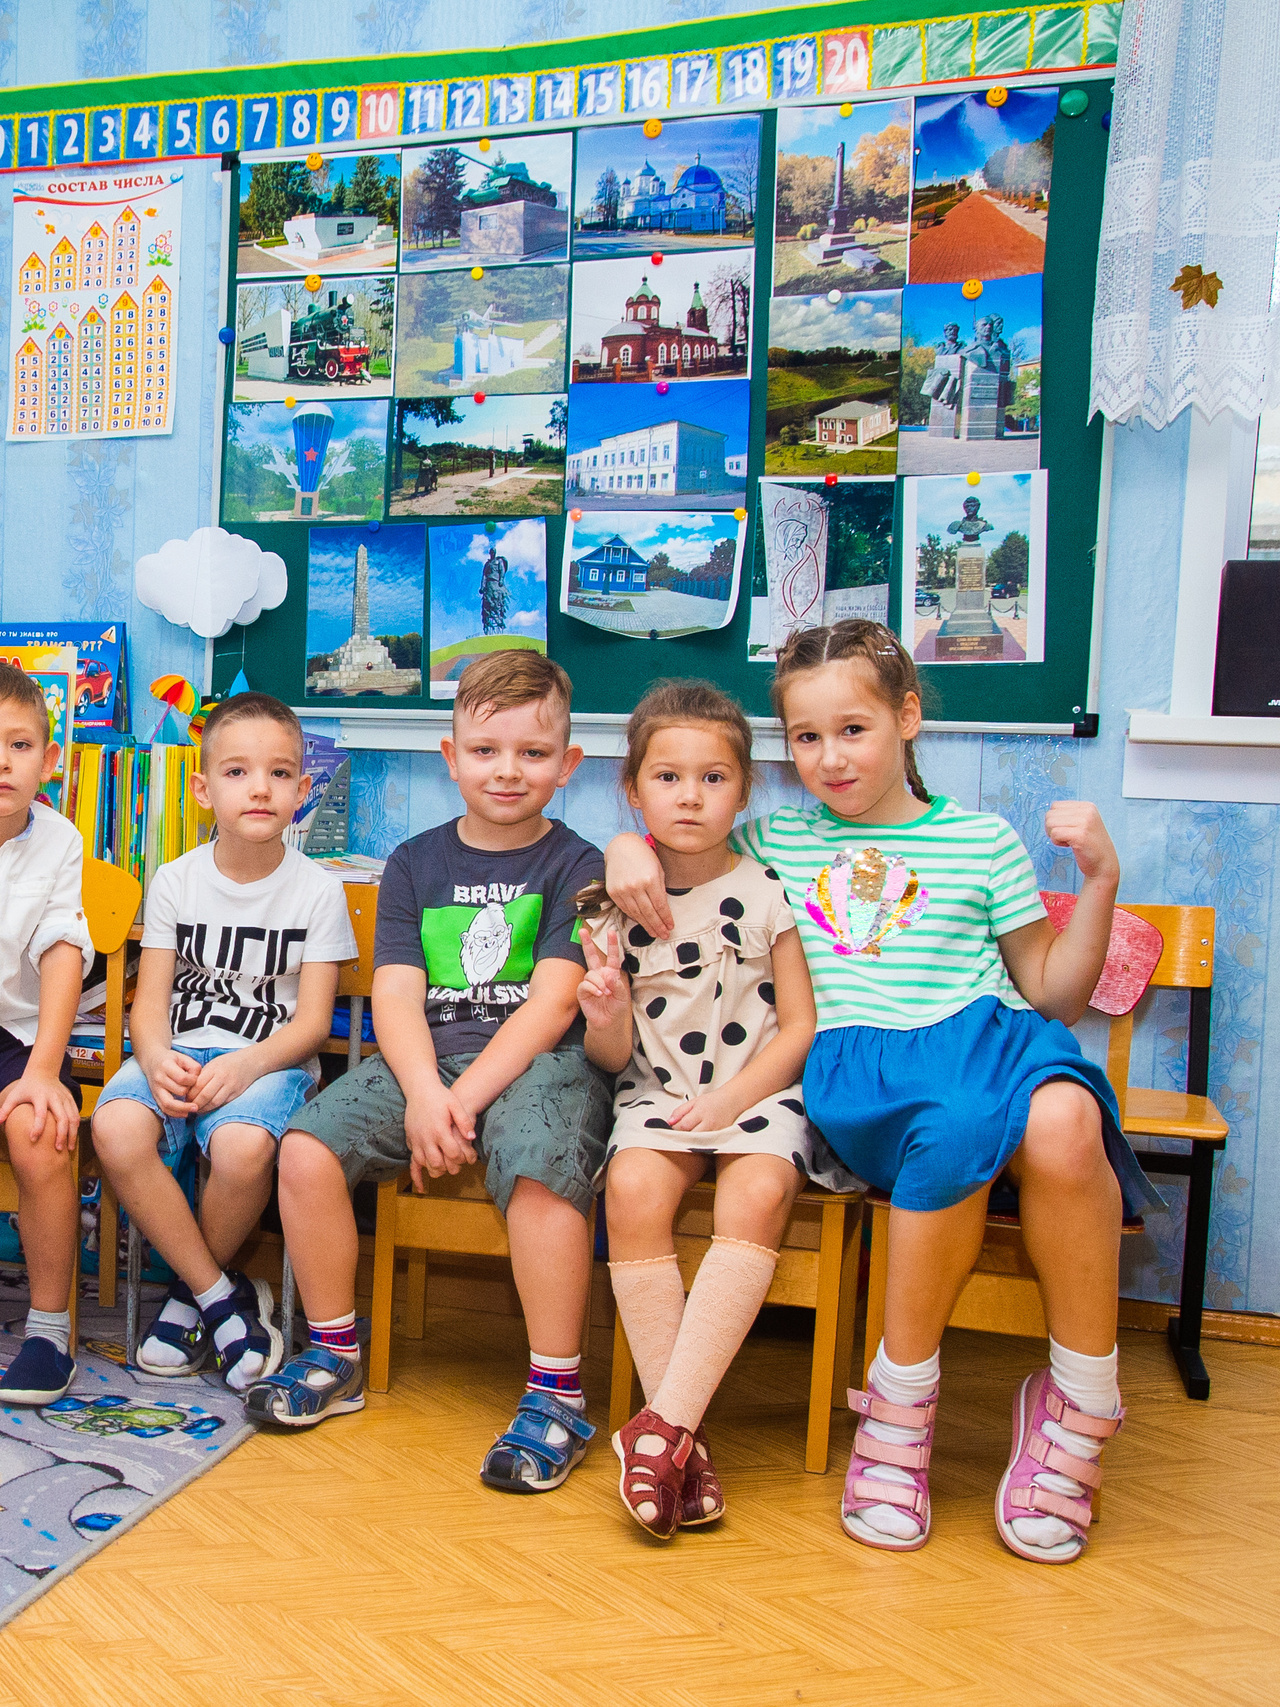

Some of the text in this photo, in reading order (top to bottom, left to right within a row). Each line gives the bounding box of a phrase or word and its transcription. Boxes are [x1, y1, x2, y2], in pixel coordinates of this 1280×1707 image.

[27, 121, 39, 159] 1
[62, 119, 80, 156] 2
[98, 116, 115, 154] 3
[132, 112, 152, 150] 4
[173, 109, 191, 148] 5
[211, 106, 230, 145] 6
[252, 102, 269, 143] 7
[291, 98, 311, 139] 8
[330, 95, 350, 137] 9
[364, 92, 394, 133] 10
[408, 89, 436, 130] 11
[451, 87, 481, 127] 12
[493, 82, 526, 123] 13
[539, 77, 572, 120] 14
[582, 71, 615, 115] 15
[627, 65, 661, 109] 16
[674, 60, 709, 103] 17
[728, 49, 765, 96] 18
[777, 43, 814, 91] 19
[825, 37, 867, 86] 20
[47, 180, 108, 194] СОСТАВ
[113, 174, 164, 190] ЧИСЛА
[427, 983, 530, 1005] IMPULSIV
[75, 1049, 86, 1057] 12
